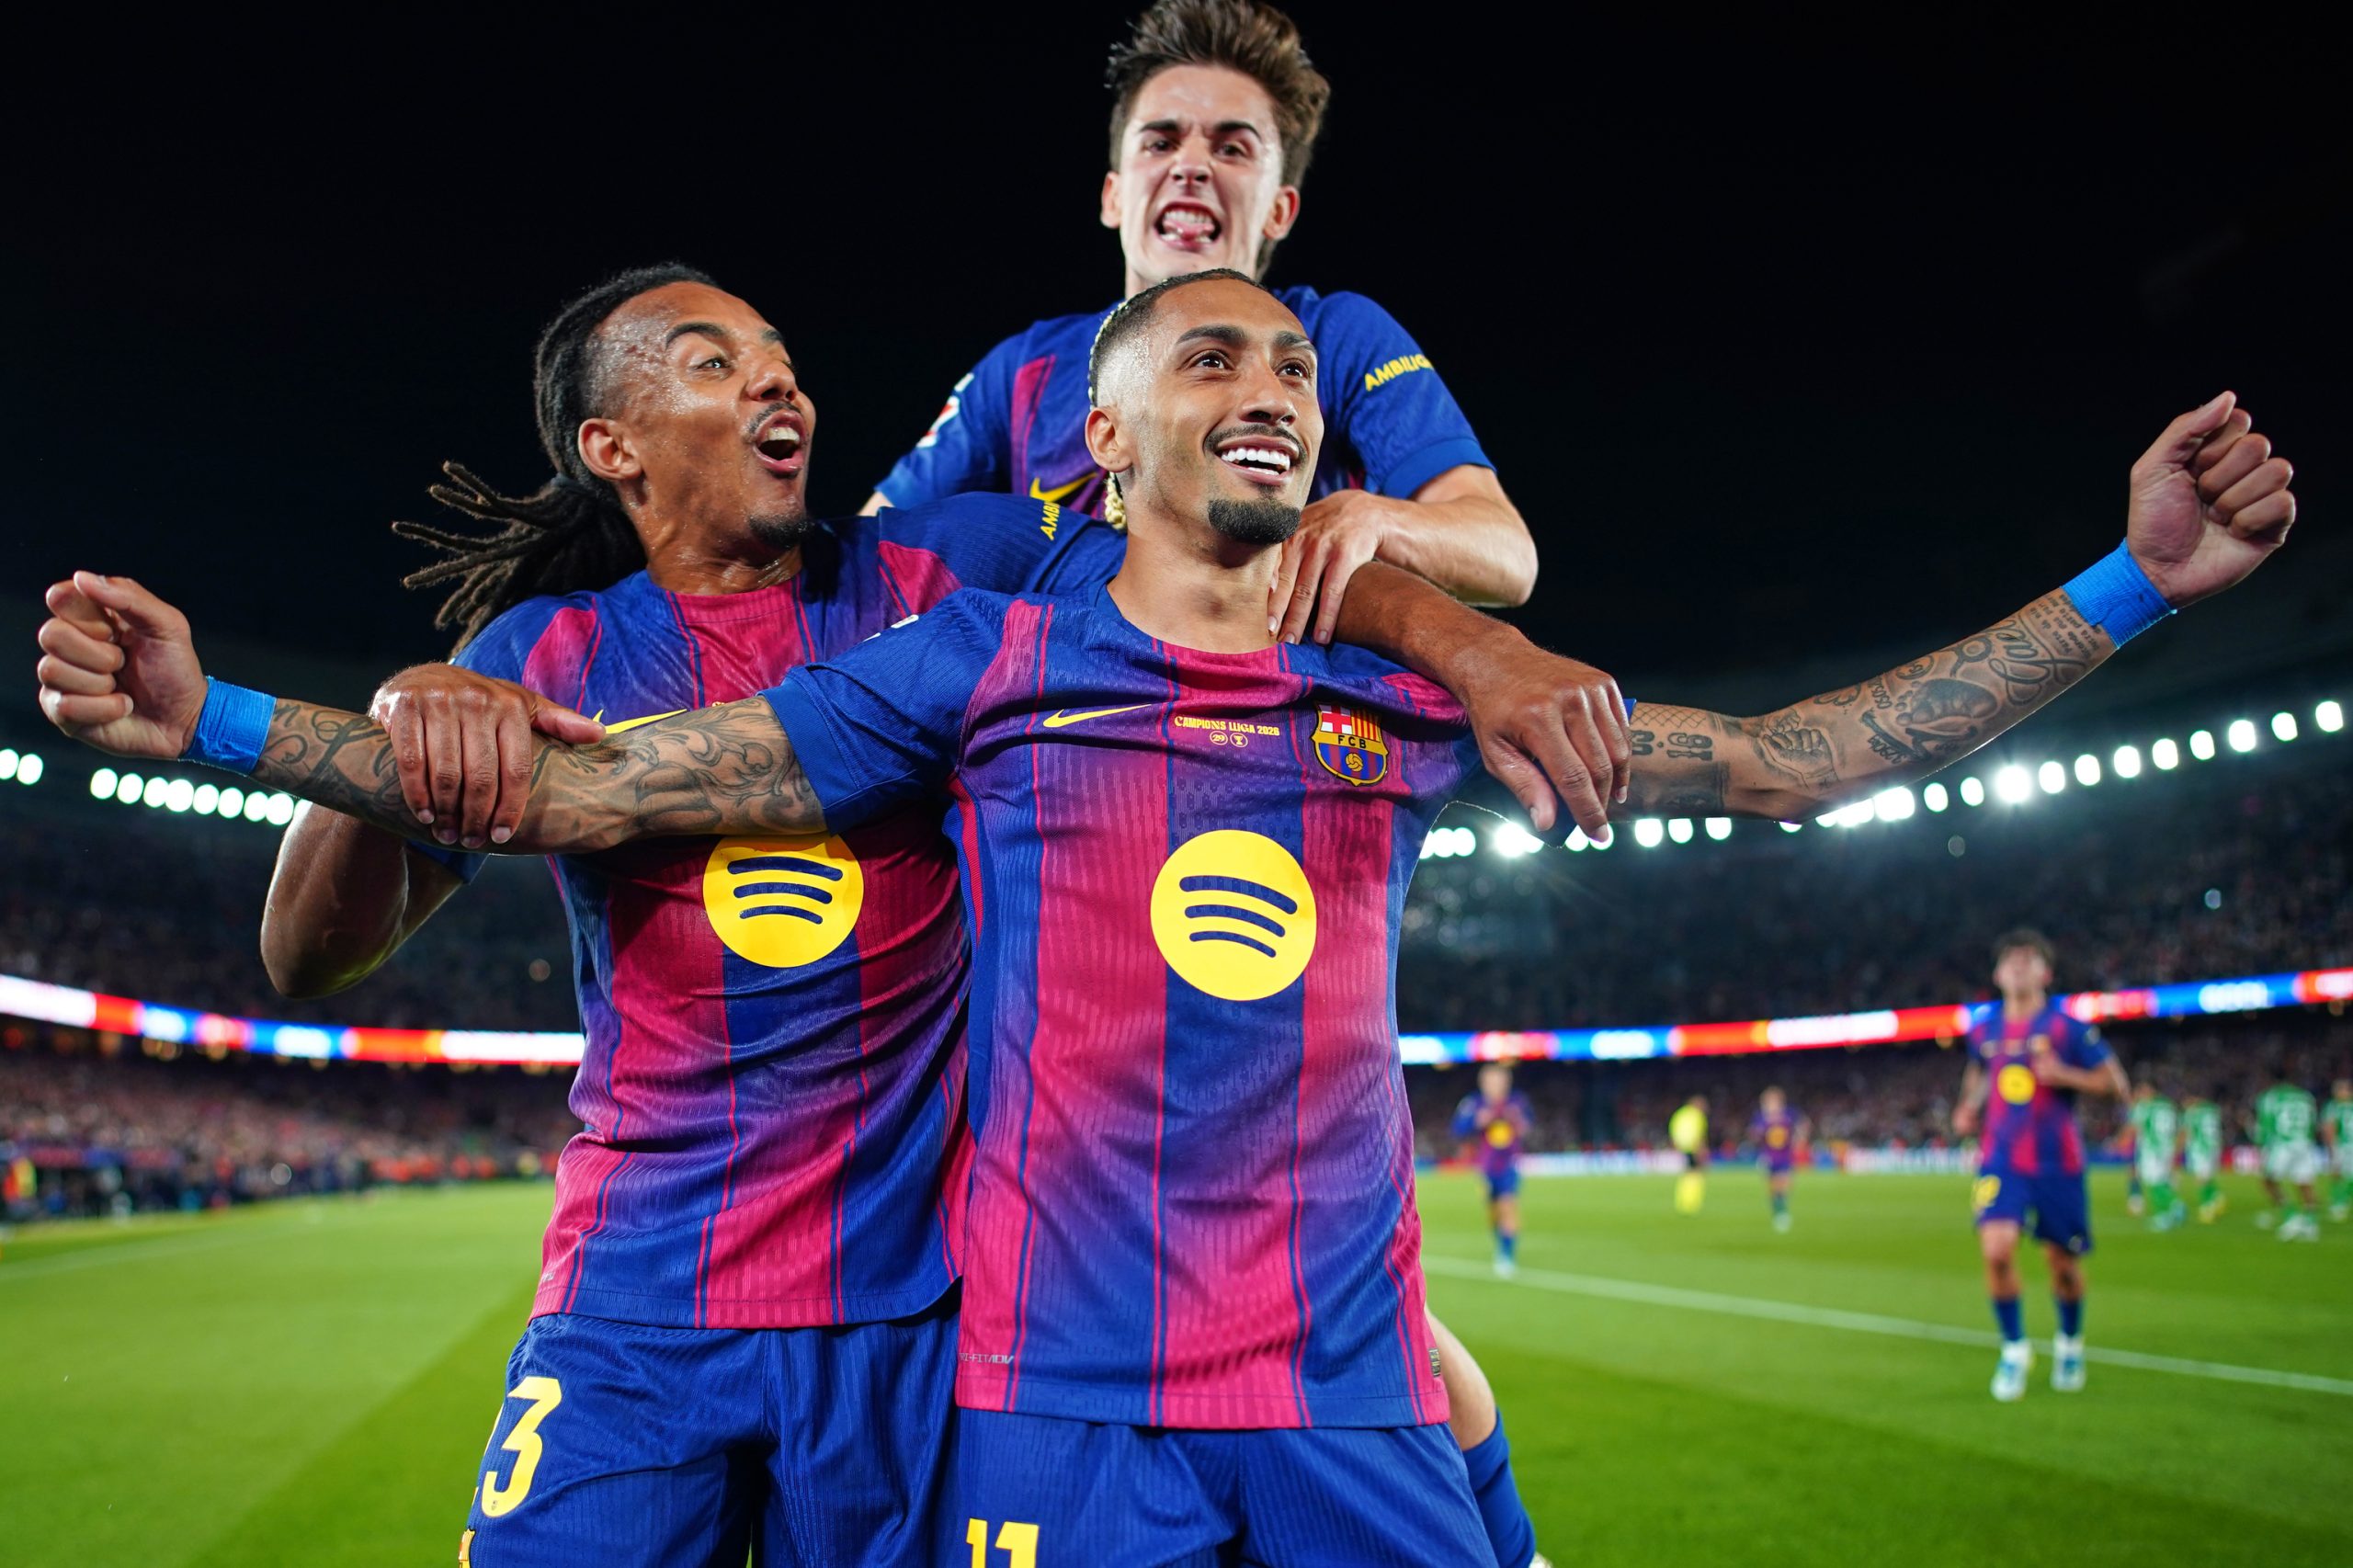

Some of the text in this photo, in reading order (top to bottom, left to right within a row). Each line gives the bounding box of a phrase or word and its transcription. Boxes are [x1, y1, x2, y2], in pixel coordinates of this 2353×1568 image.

[1175, 716, 1226, 731] CAMPIONS
[1257, 725, 1280, 736] 2026
[1212, 733, 1225, 743] 29
[1337, 734, 1367, 749] FCB
[471, 1375, 563, 1518] 3
